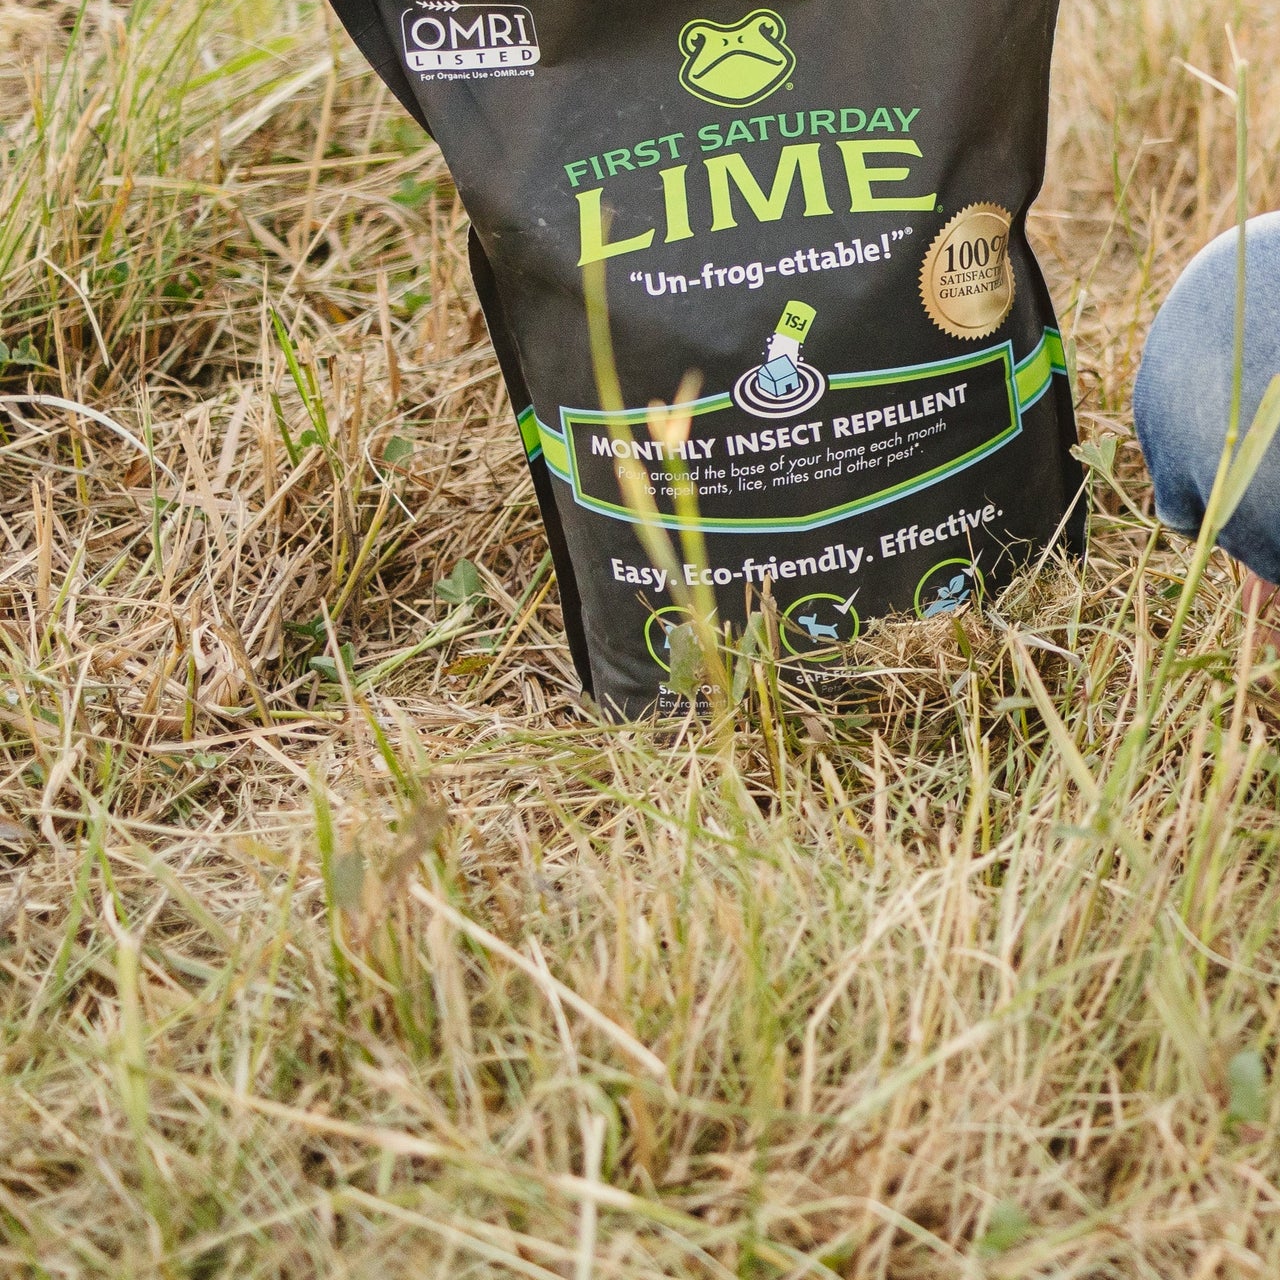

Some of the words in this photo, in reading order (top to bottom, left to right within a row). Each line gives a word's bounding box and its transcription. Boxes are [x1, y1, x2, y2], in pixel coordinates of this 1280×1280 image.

[411, 13, 531, 50] OMRI
[415, 49, 533, 67] LISTED
[420, 72, 435, 81] For
[437, 71, 471, 81] Organic
[472, 71, 488, 80] Use
[493, 69, 535, 78] OMRI.org
[563, 132, 685, 188] FIRST
[697, 107, 922, 152] SATURDAY
[575, 139, 938, 267] LIME
[944, 233, 1006, 273] 100%
[940, 264, 1003, 286] SATISFACT
[785, 312, 807, 331] FSL
[591, 435, 716, 461] MONTHLY
[726, 422, 823, 456] INSECT
[833, 383, 968, 439] REPELLENT
[618, 466, 647, 480] Pour
[650, 466, 700, 481] around
[704, 466, 726, 480] the
[731, 462, 765, 478] base
[770, 455, 785, 471] of
[789, 453, 822, 472] your
[827, 447, 865, 462] home
[870, 432, 902, 452] each
[907, 419, 947, 442] month
[644, 483, 656, 495] to
[661, 481, 694, 499] repel
[699, 483, 732, 495] ants,
[739, 477, 767, 492] lice,
[772, 471, 809, 486] mites
[814, 461, 842, 480] and
[847, 455, 883, 474] other
[611, 558, 677, 592] Easy.
[683, 544, 873, 586] Eco-friendly.
[881, 503, 1003, 558] Effective.
[695, 684, 721, 696] OR
